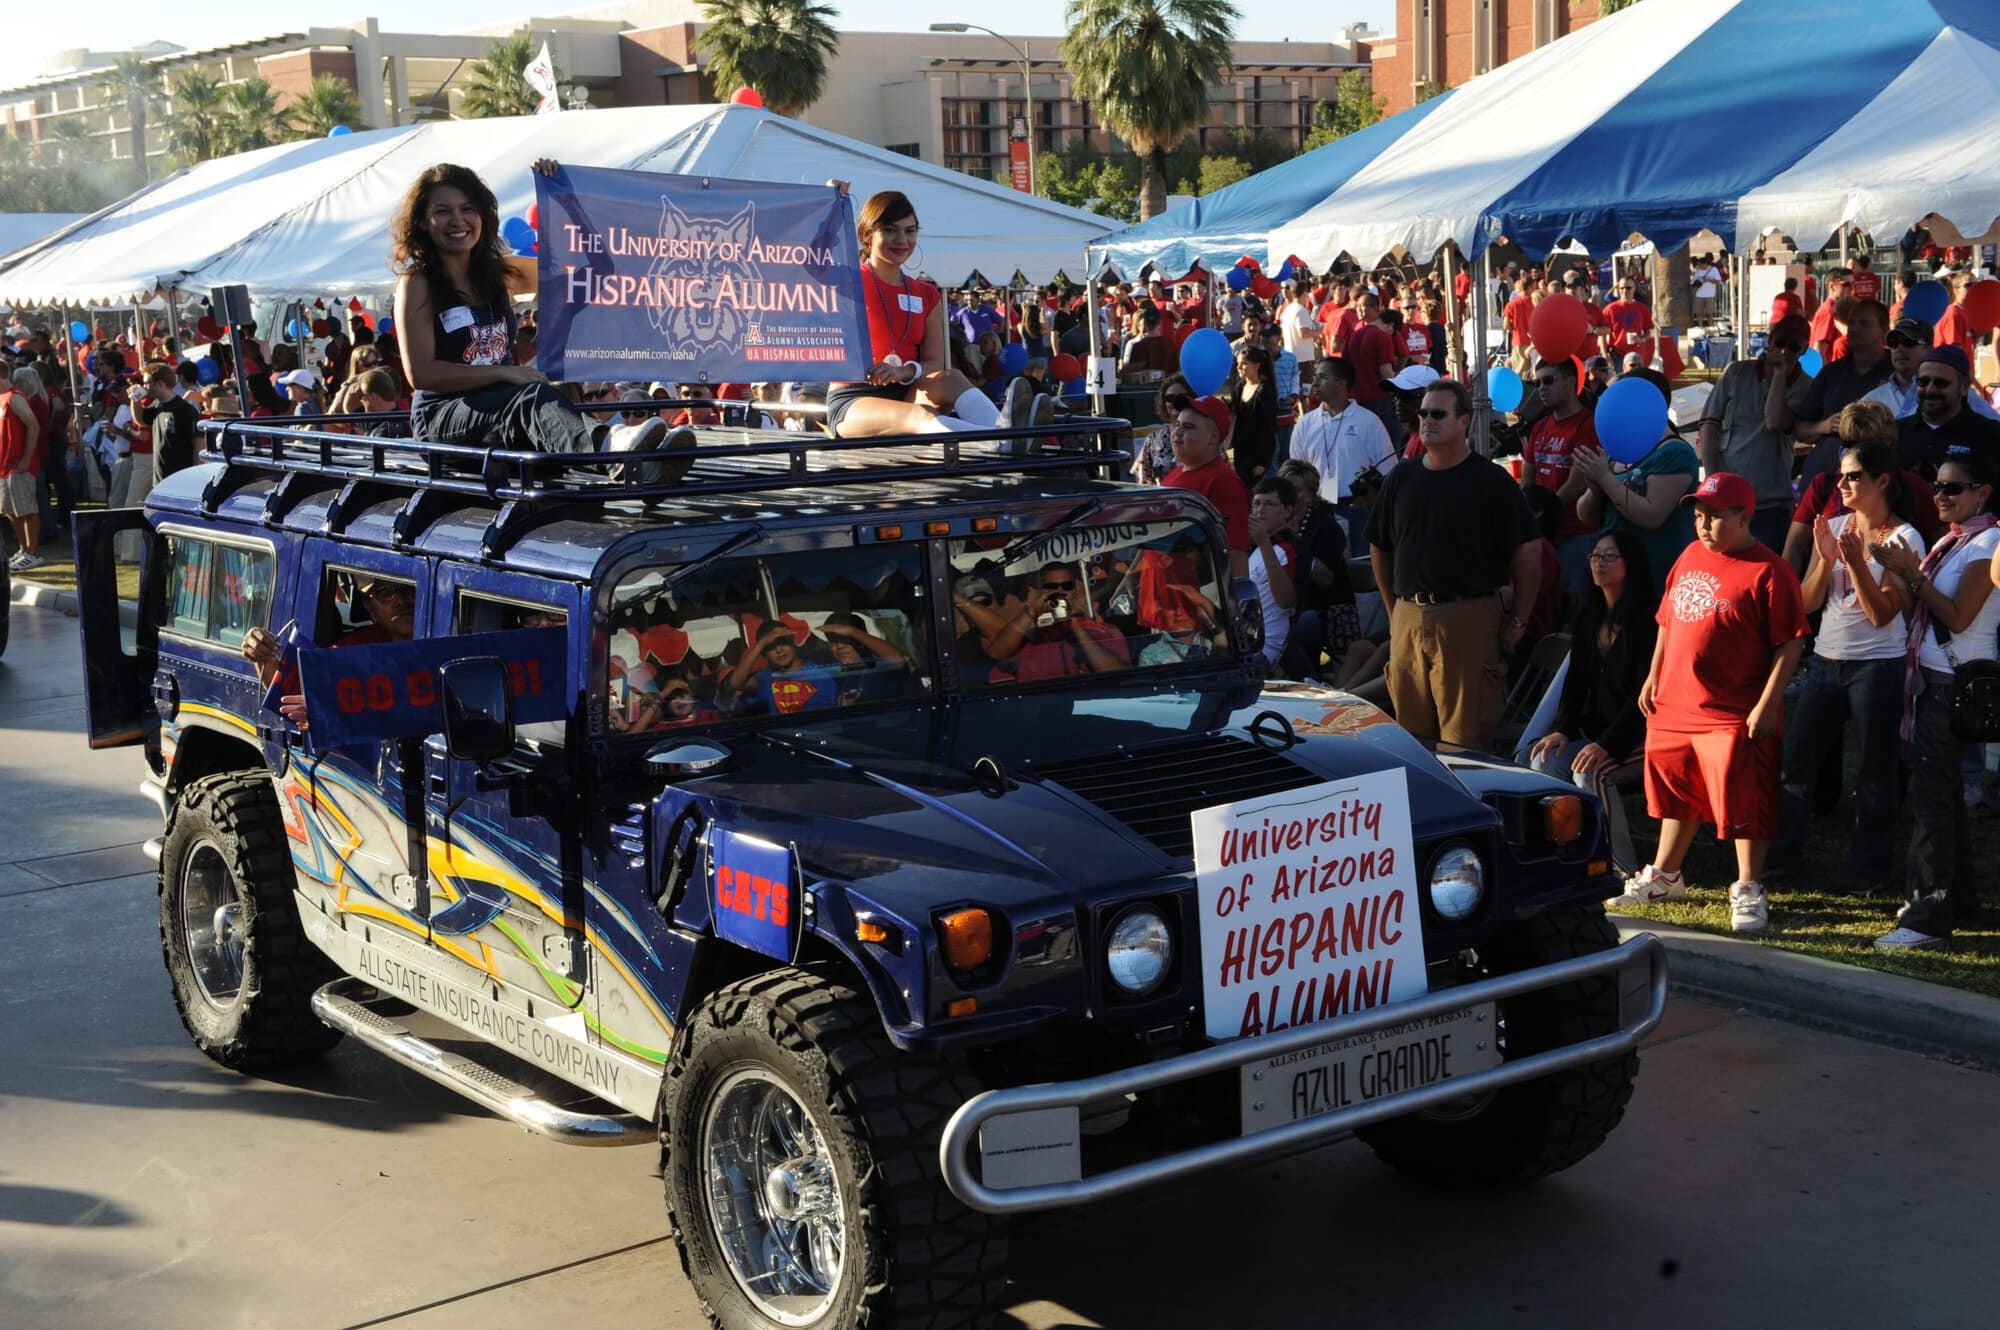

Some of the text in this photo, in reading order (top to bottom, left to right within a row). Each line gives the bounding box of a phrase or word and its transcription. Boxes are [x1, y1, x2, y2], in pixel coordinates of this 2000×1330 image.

[608, 227, 715, 260] UNIVERSITY
[747, 236, 834, 266] ARIZONA
[566, 266, 839, 313] HISPANIC ALUMNI
[747, 348, 845, 361] UA HISPANIC ALUMNI
[797, 336, 844, 345] ASSOCIATION
[336, 659, 542, 714] GO CS!
[1220, 799, 1382, 867] University
[717, 864, 789, 928] CATS
[1216, 847, 1395, 917] of Arizona
[1220, 889, 1405, 988] HISPANIC
[359, 947, 620, 1095] ALLSTATE INSURANCE COMPANY
[1239, 958, 1394, 1037] ALUMNI
[1268, 1007, 1474, 1069] ALLSTATE INSURANCE COMPANY PRESENTS
[1292, 1034, 1453, 1120] AZUL GRANDE
